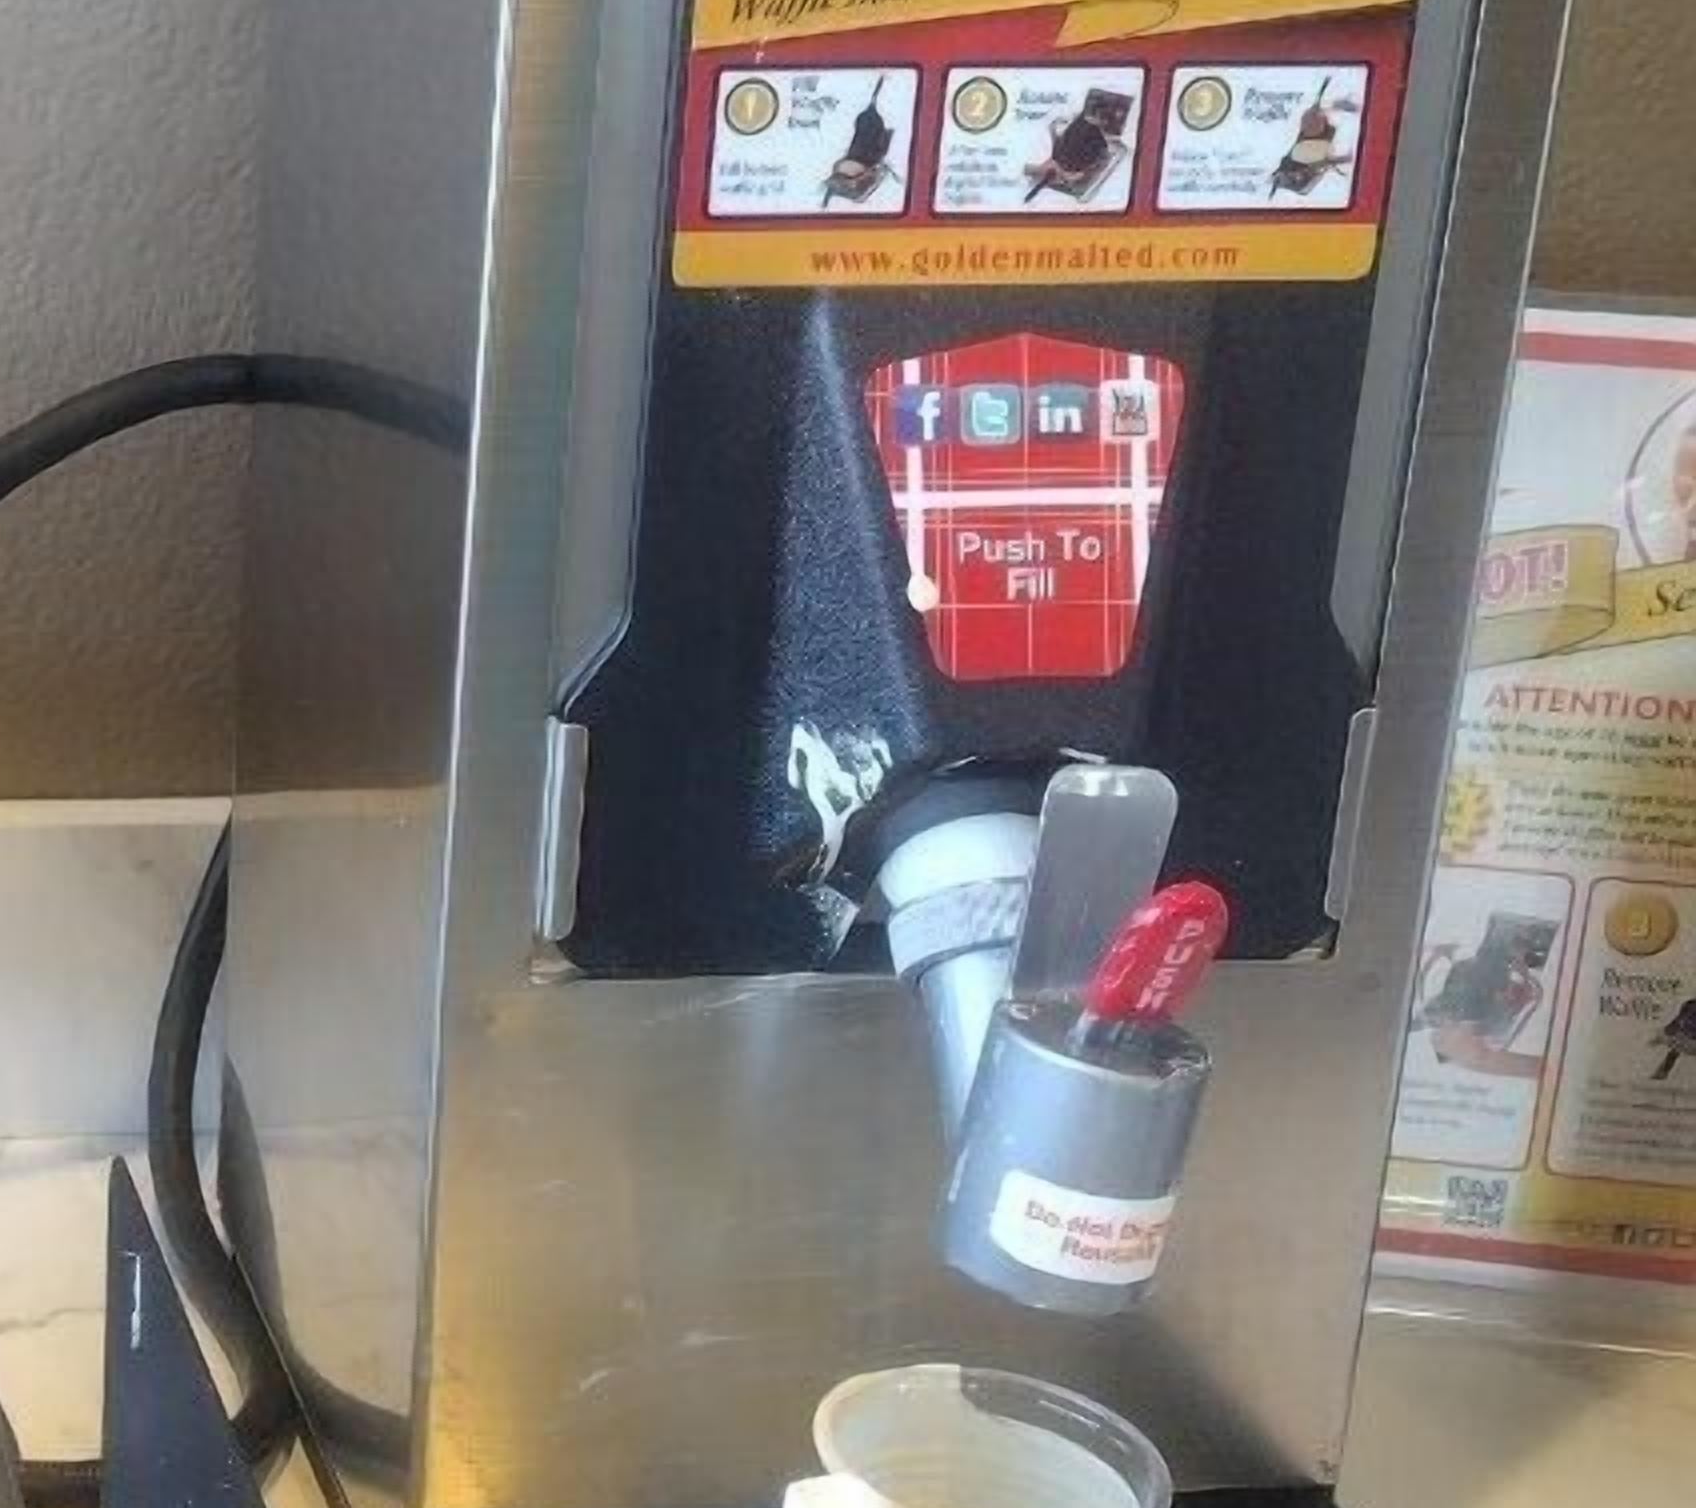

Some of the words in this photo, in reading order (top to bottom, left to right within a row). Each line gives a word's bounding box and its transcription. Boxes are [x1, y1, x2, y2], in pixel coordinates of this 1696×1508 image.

[810, 242, 1240, 276] www.goldenmalted.com
[957, 531, 1046, 565] Push
[1056, 529, 1102, 561] To
[1005, 567, 1057, 601] Fill
[1478, 542, 1568, 602] OT!
[1484, 683, 1696, 723] ATTENTION
